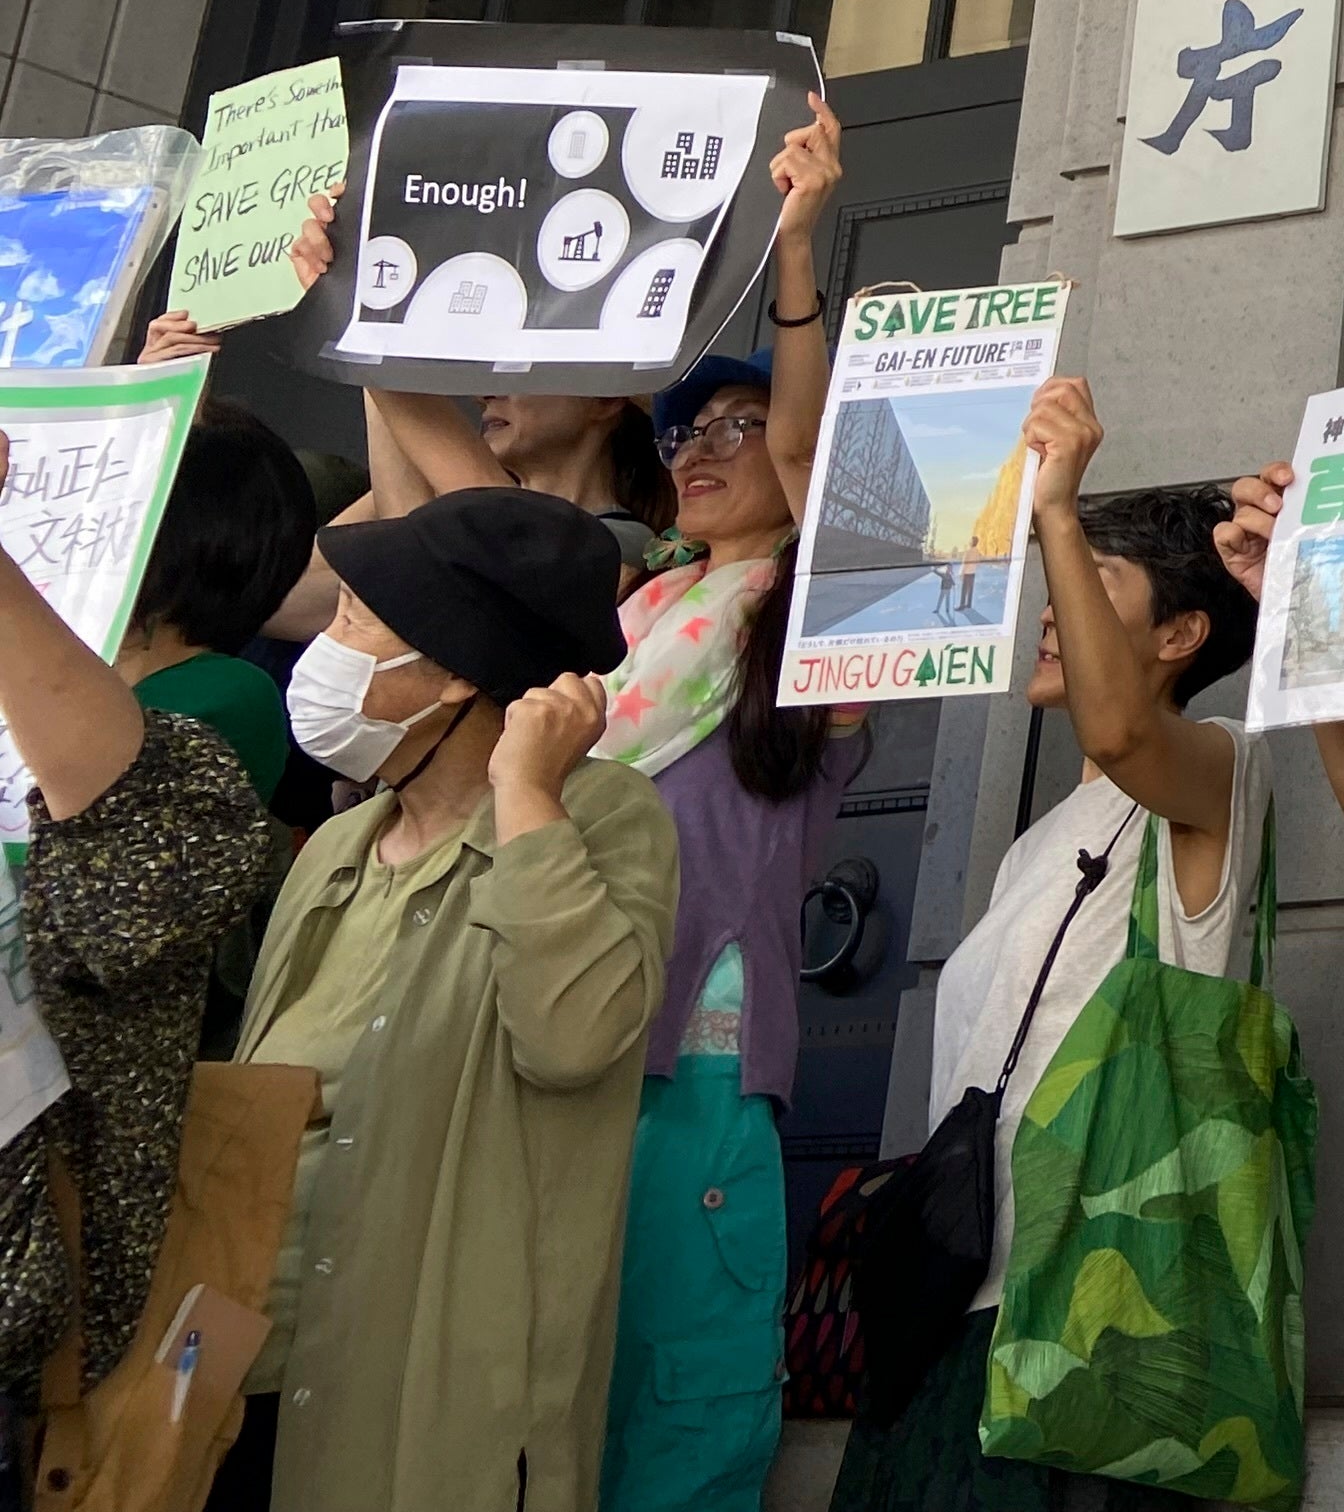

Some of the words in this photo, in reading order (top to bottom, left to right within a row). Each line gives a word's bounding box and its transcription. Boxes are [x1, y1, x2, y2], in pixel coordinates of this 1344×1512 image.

[214, 89, 276, 132] There's
[203, 120, 304, 175] Important
[192, 181, 258, 232] SAVE
[404, 174, 527, 214] Enough!
[180, 243, 243, 292] SAVE
[249, 233, 295, 267] OUR
[965, 287, 1059, 330] TREE
[875, 348, 938, 373] GAI-EN
[939, 342, 1011, 368] FUTURE
[793, 653, 888, 693] JINGU
